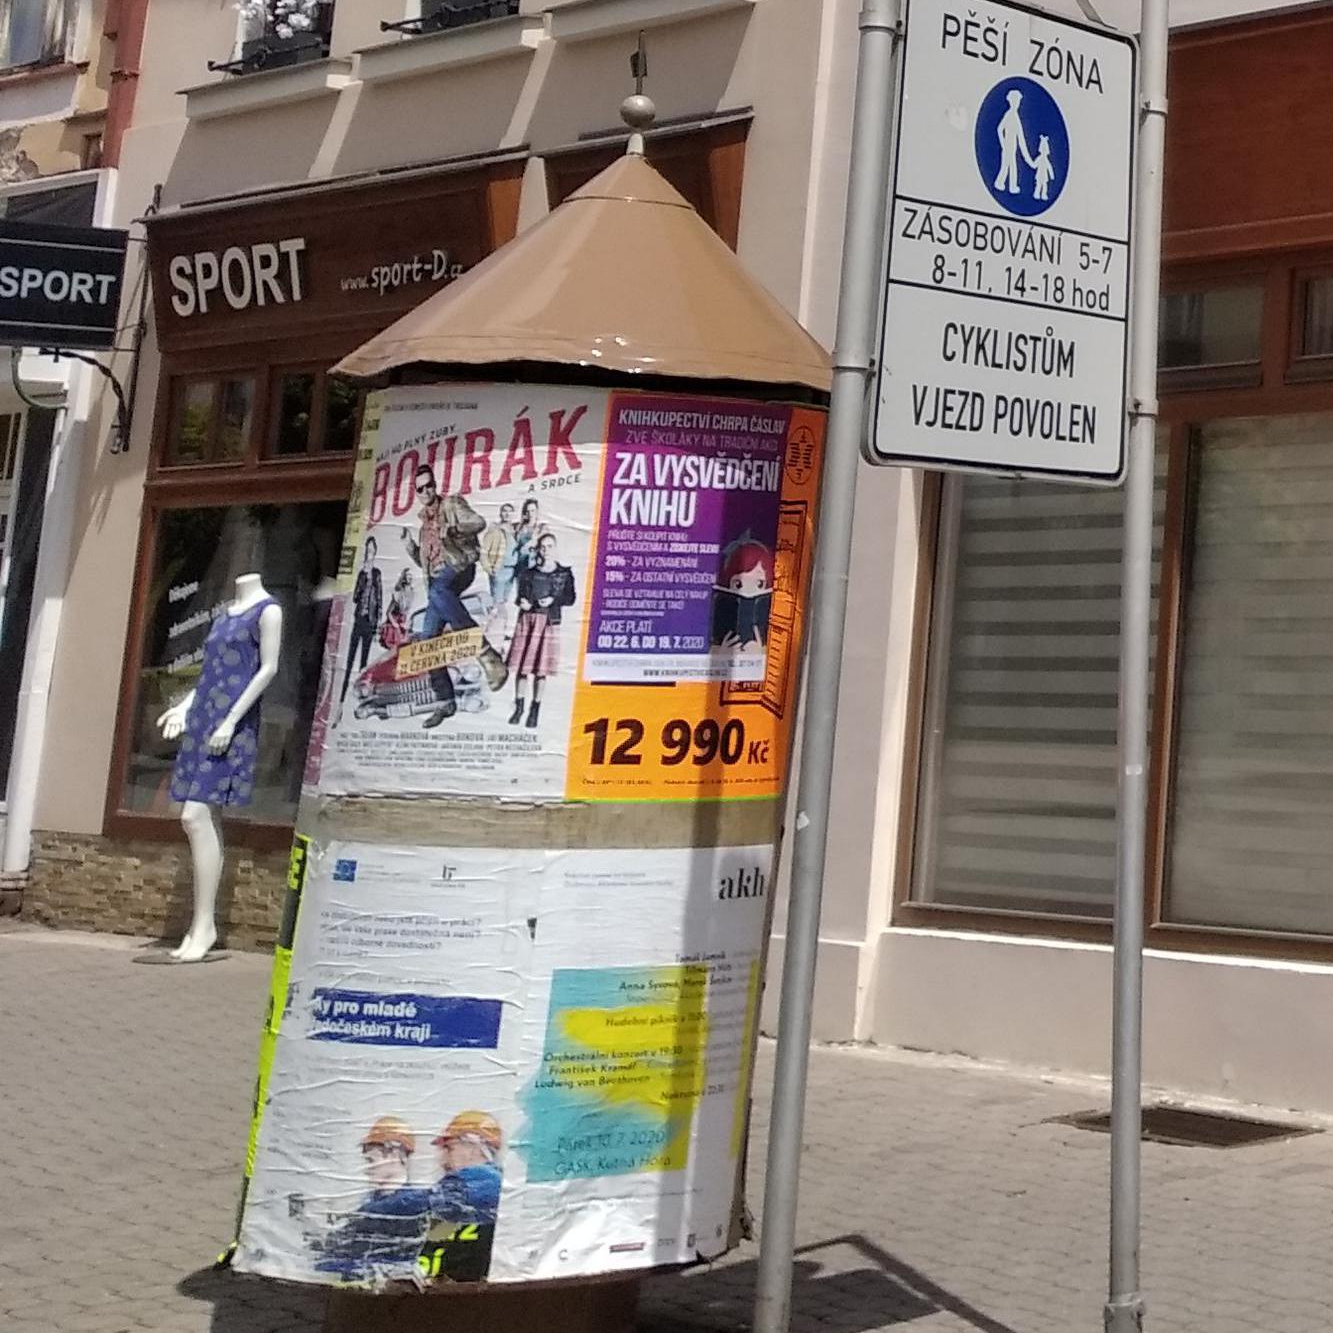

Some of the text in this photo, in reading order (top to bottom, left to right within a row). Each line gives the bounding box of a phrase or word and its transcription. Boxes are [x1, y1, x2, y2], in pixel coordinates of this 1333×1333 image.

[941, 9, 1104, 94] PĚŠÍ ZÓNA
[901, 205, 1113, 274] ZÁSOBOVÁNÍ 5-7
[0, 265, 117, 305] SPORT
[169, 238, 307, 318] SPORT
[1004, 266, 1065, 304] 14-18
[1072, 278, 1110, 312] hod
[941, 321, 1076, 379] CYKLISTŮM
[618, 408, 711, 429] KNIHKUPECTVÍ
[911, 384, 1097, 445] VJEZD POVOLEN
[366, 405, 589, 531] BOURÁK
[540, 473, 583, 491] SRDCE
[612, 451, 782, 492] ZA VYSVĚDČENÍ
[608, 488, 698, 528] KNIHU
[598, 619, 625, 634] AKCE
[583, 717, 770, 766] 12 990 Kč
[333, 1000, 360, 1016] pro
[362, 1000, 418, 1018] mladé
[394, 1024, 431, 1043] kraji
